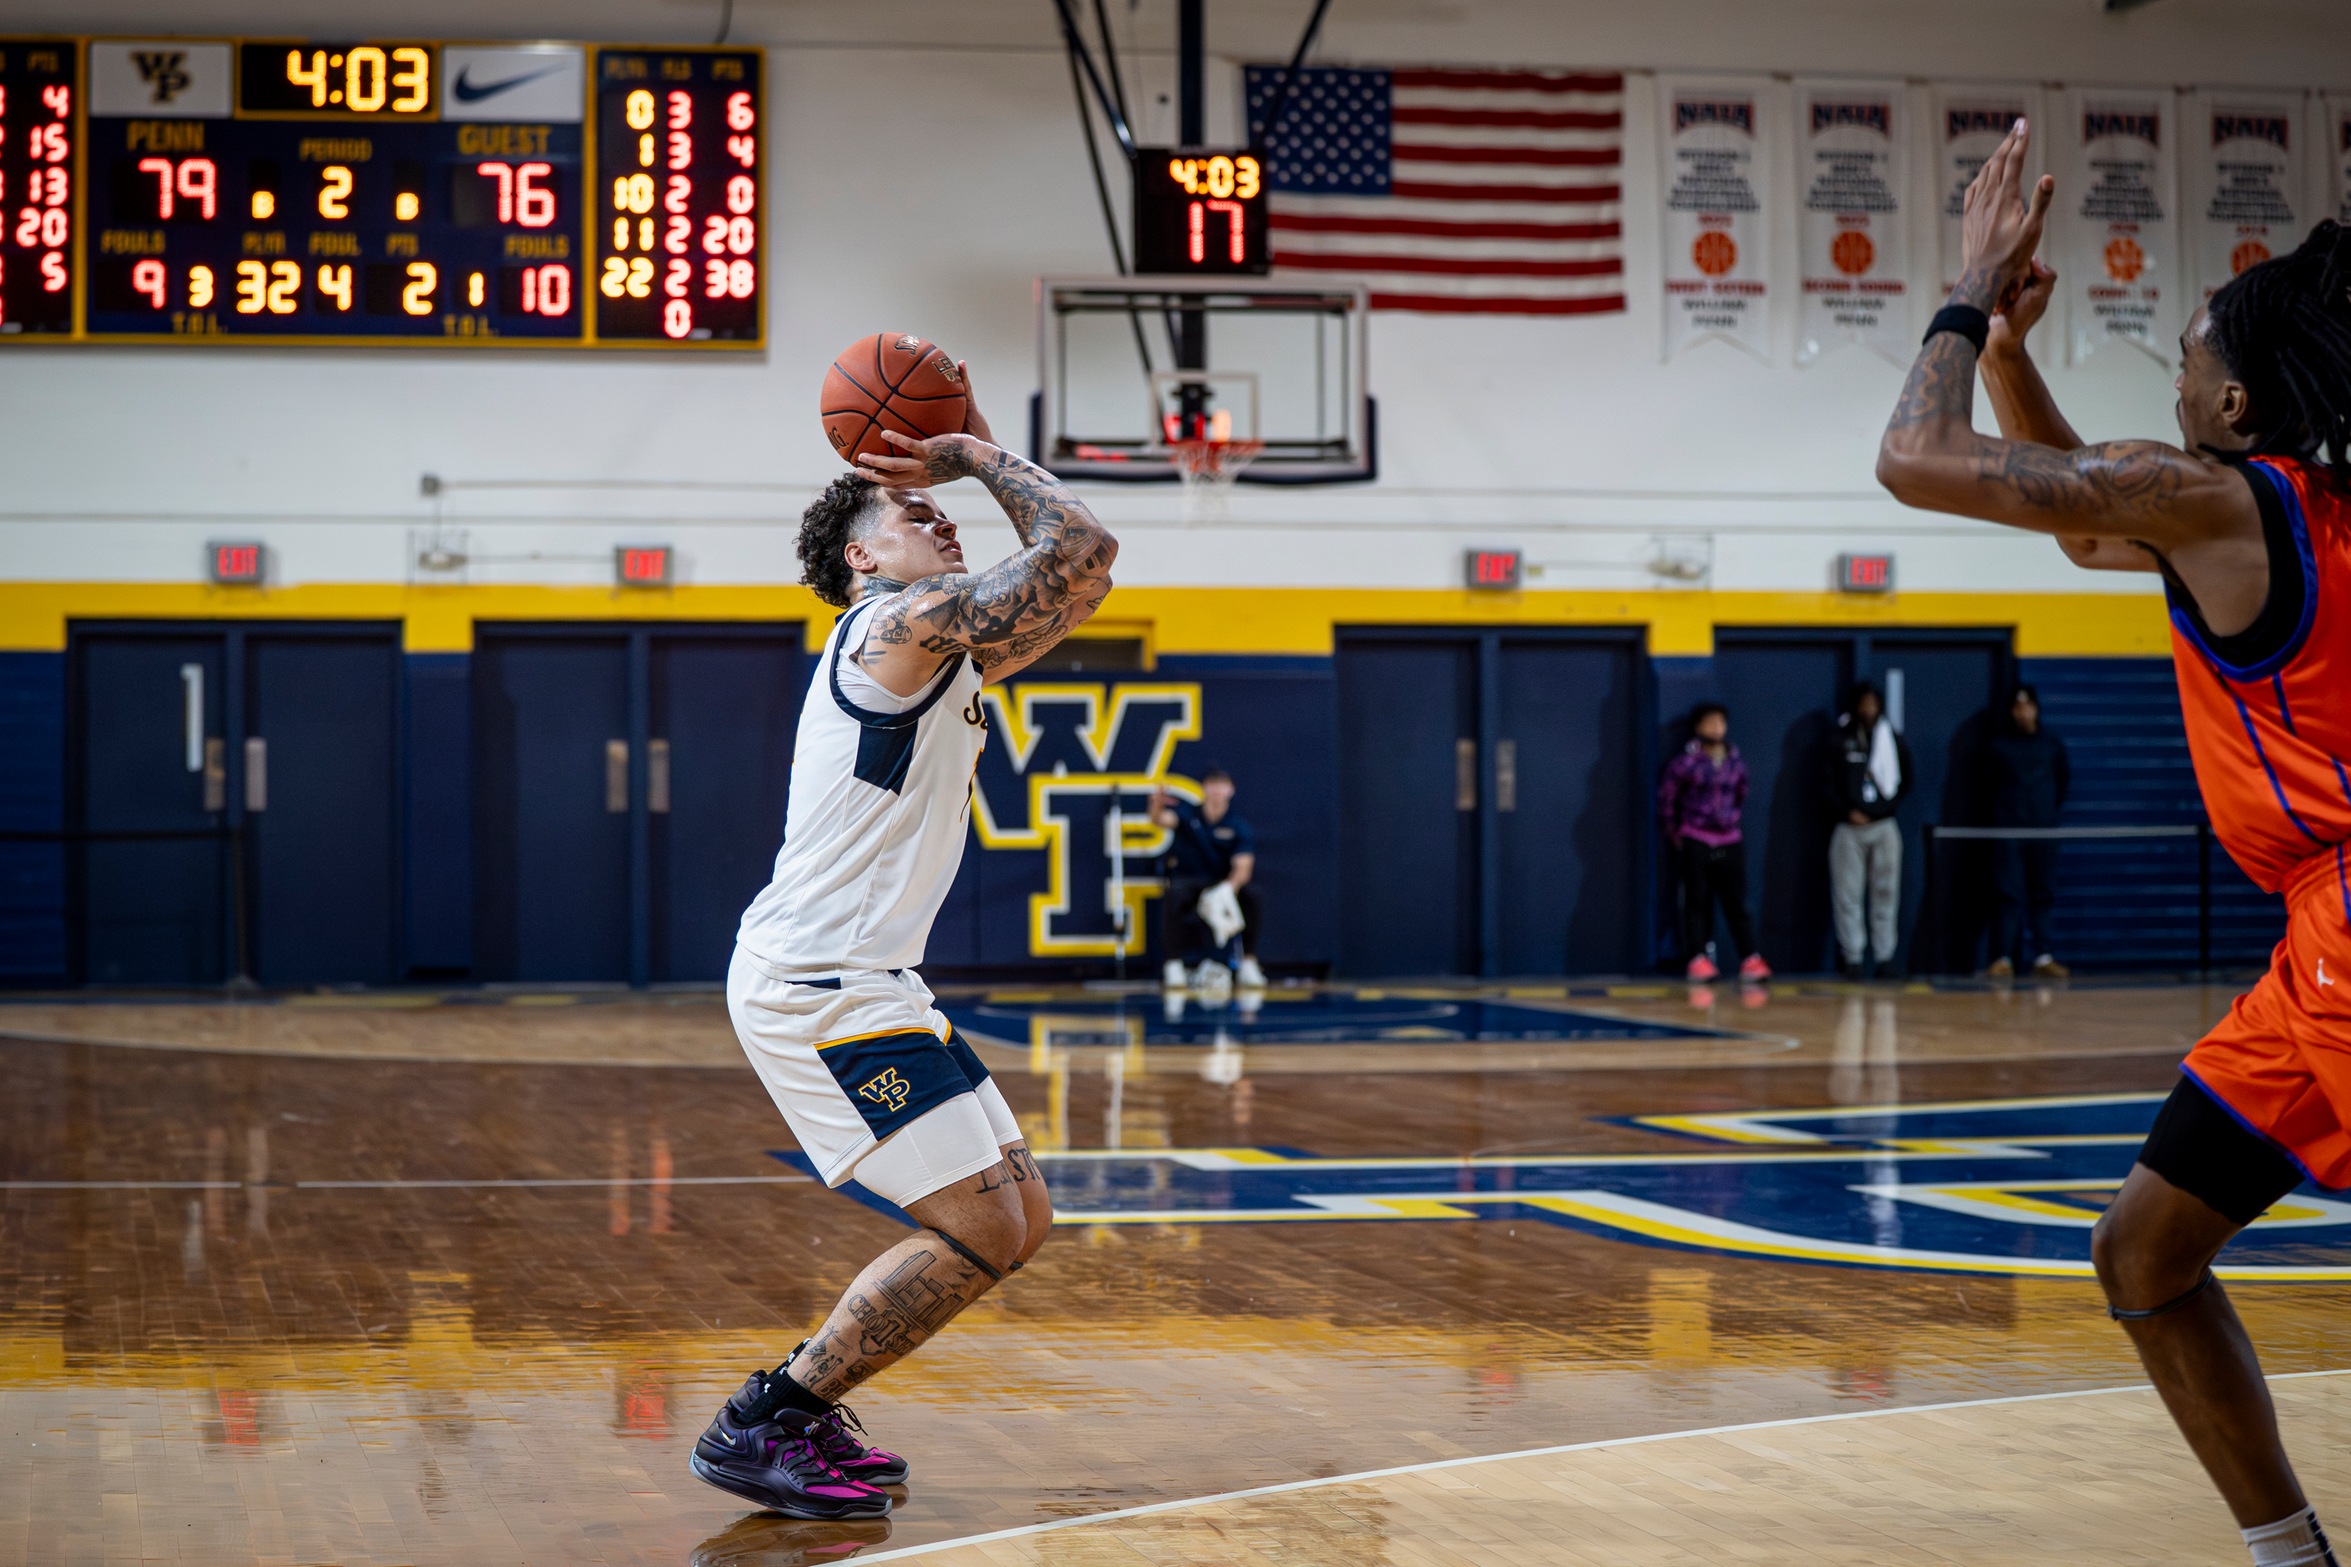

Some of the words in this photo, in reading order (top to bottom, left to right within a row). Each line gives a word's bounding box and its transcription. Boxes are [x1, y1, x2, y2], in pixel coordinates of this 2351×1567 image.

[129, 51, 194, 104] WP
[287, 47, 429, 112] 4:03
[43, 85, 69, 118] 4
[626, 89, 655, 130] 0
[667, 90, 692, 130] 3
[727, 92, 754, 130] 6
[1672, 103, 1756, 137] NAIA
[1811, 104, 1891, 139] NAIA
[30, 122, 69, 162] 15
[127, 120, 204, 153] PENN
[457, 125, 553, 155] GUEST
[2083, 113, 2160, 147] NAIA
[2212, 117, 2288, 152] NAIA
[300, 138, 373, 163] PERIOD
[639, 133, 655, 167] 1
[667, 131, 692, 170] 3
[727, 135, 754, 168] 4
[29, 166, 68, 206] 13
[138, 158, 217, 220] 79
[318, 166, 353, 219] 2
[477, 162, 555, 228] 76
[614, 173, 655, 214] 10
[664, 174, 692, 214] 2
[727, 175, 754, 214] 0
[1169, 156, 1260, 199] 4:03
[16, 207, 68, 247] 20
[101, 230, 166, 255] FOULS
[504, 234, 570, 259] FOULS
[614, 217, 655, 251] 11
[664, 215, 692, 254] 2
[702, 215, 754, 255] 20
[1189, 199, 1245, 264] 17
[40, 251, 67, 292] 5
[132, 259, 166, 310] 9
[189, 265, 213, 307] 3
[236, 260, 301, 314] 32
[317, 264, 353, 311] 4
[402, 262, 437, 315] 2
[469, 272, 484, 307] 1
[522, 264, 570, 316] 10
[600, 256, 655, 298] 22
[664, 258, 692, 298] 2
[704, 258, 754, 298] 38
[664, 299, 692, 339] 0
[217, 545, 258, 577] EXIT
[624, 548, 664, 580] EXIT
[1477, 551, 1515, 583] EXIT
[1852, 556, 1887, 586] EXIT
[858, 1067, 910, 1112] WP
